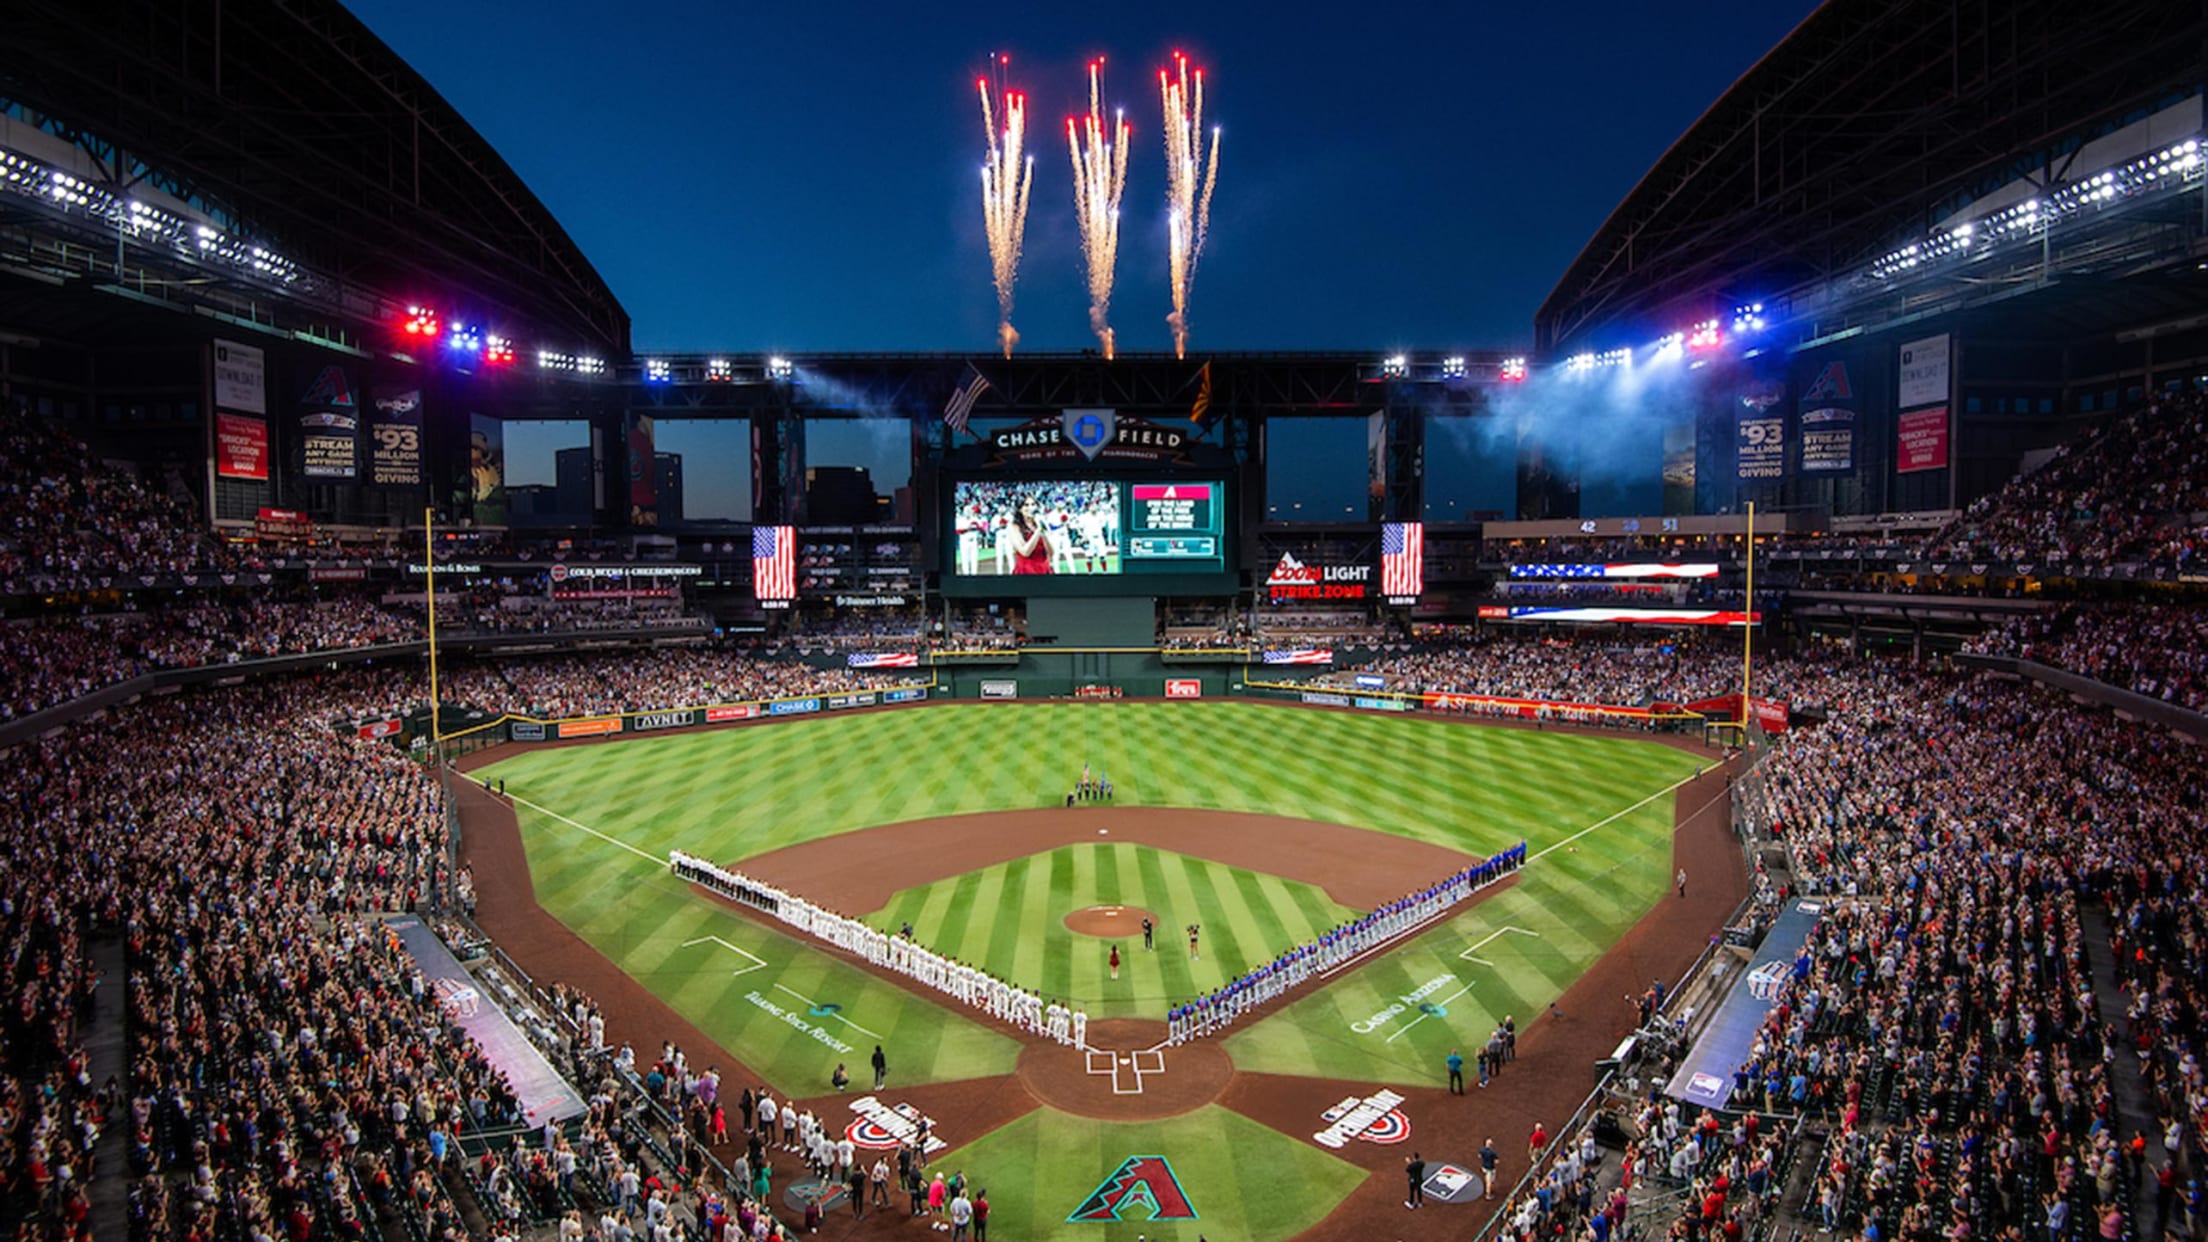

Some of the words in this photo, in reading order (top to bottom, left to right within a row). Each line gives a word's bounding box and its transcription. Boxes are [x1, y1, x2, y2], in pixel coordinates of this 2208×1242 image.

[997, 429, 1060, 447] CHASE
[1118, 429, 1181, 447] FIELD
[1803, 434, 1851, 445] STREAM
[304, 439, 354, 449] STREAM
[1739, 445, 1783, 454] MILLION
[305, 449, 326, 457] ANY
[374, 450, 419, 460] MILLION
[1102, 450, 1158, 459] DIAMONDBACKS
[1739, 467, 1783, 477] GIVING
[374, 474, 420, 484] GIVING
[1580, 521, 1596, 533] 42
[409, 564, 447, 574] BOURON
[456, 564, 480, 573] BONES
[1271, 559, 1323, 581] Coors
[1323, 566, 1370, 581] LIGHT
[1270, 584, 1319, 598] STRIKE
[1323, 584, 1365, 598] ZONE
[776, 699, 805, 711] CHASE
[642, 710, 690, 728] AVNET
[1350, 1003, 1406, 1034] CASINO
[1398, 973, 1457, 1006] ARIZONA
[744, 991, 785, 1016] TALKING
[780, 1012, 812, 1032] STICK
[808, 1027, 854, 1054] RESORT
